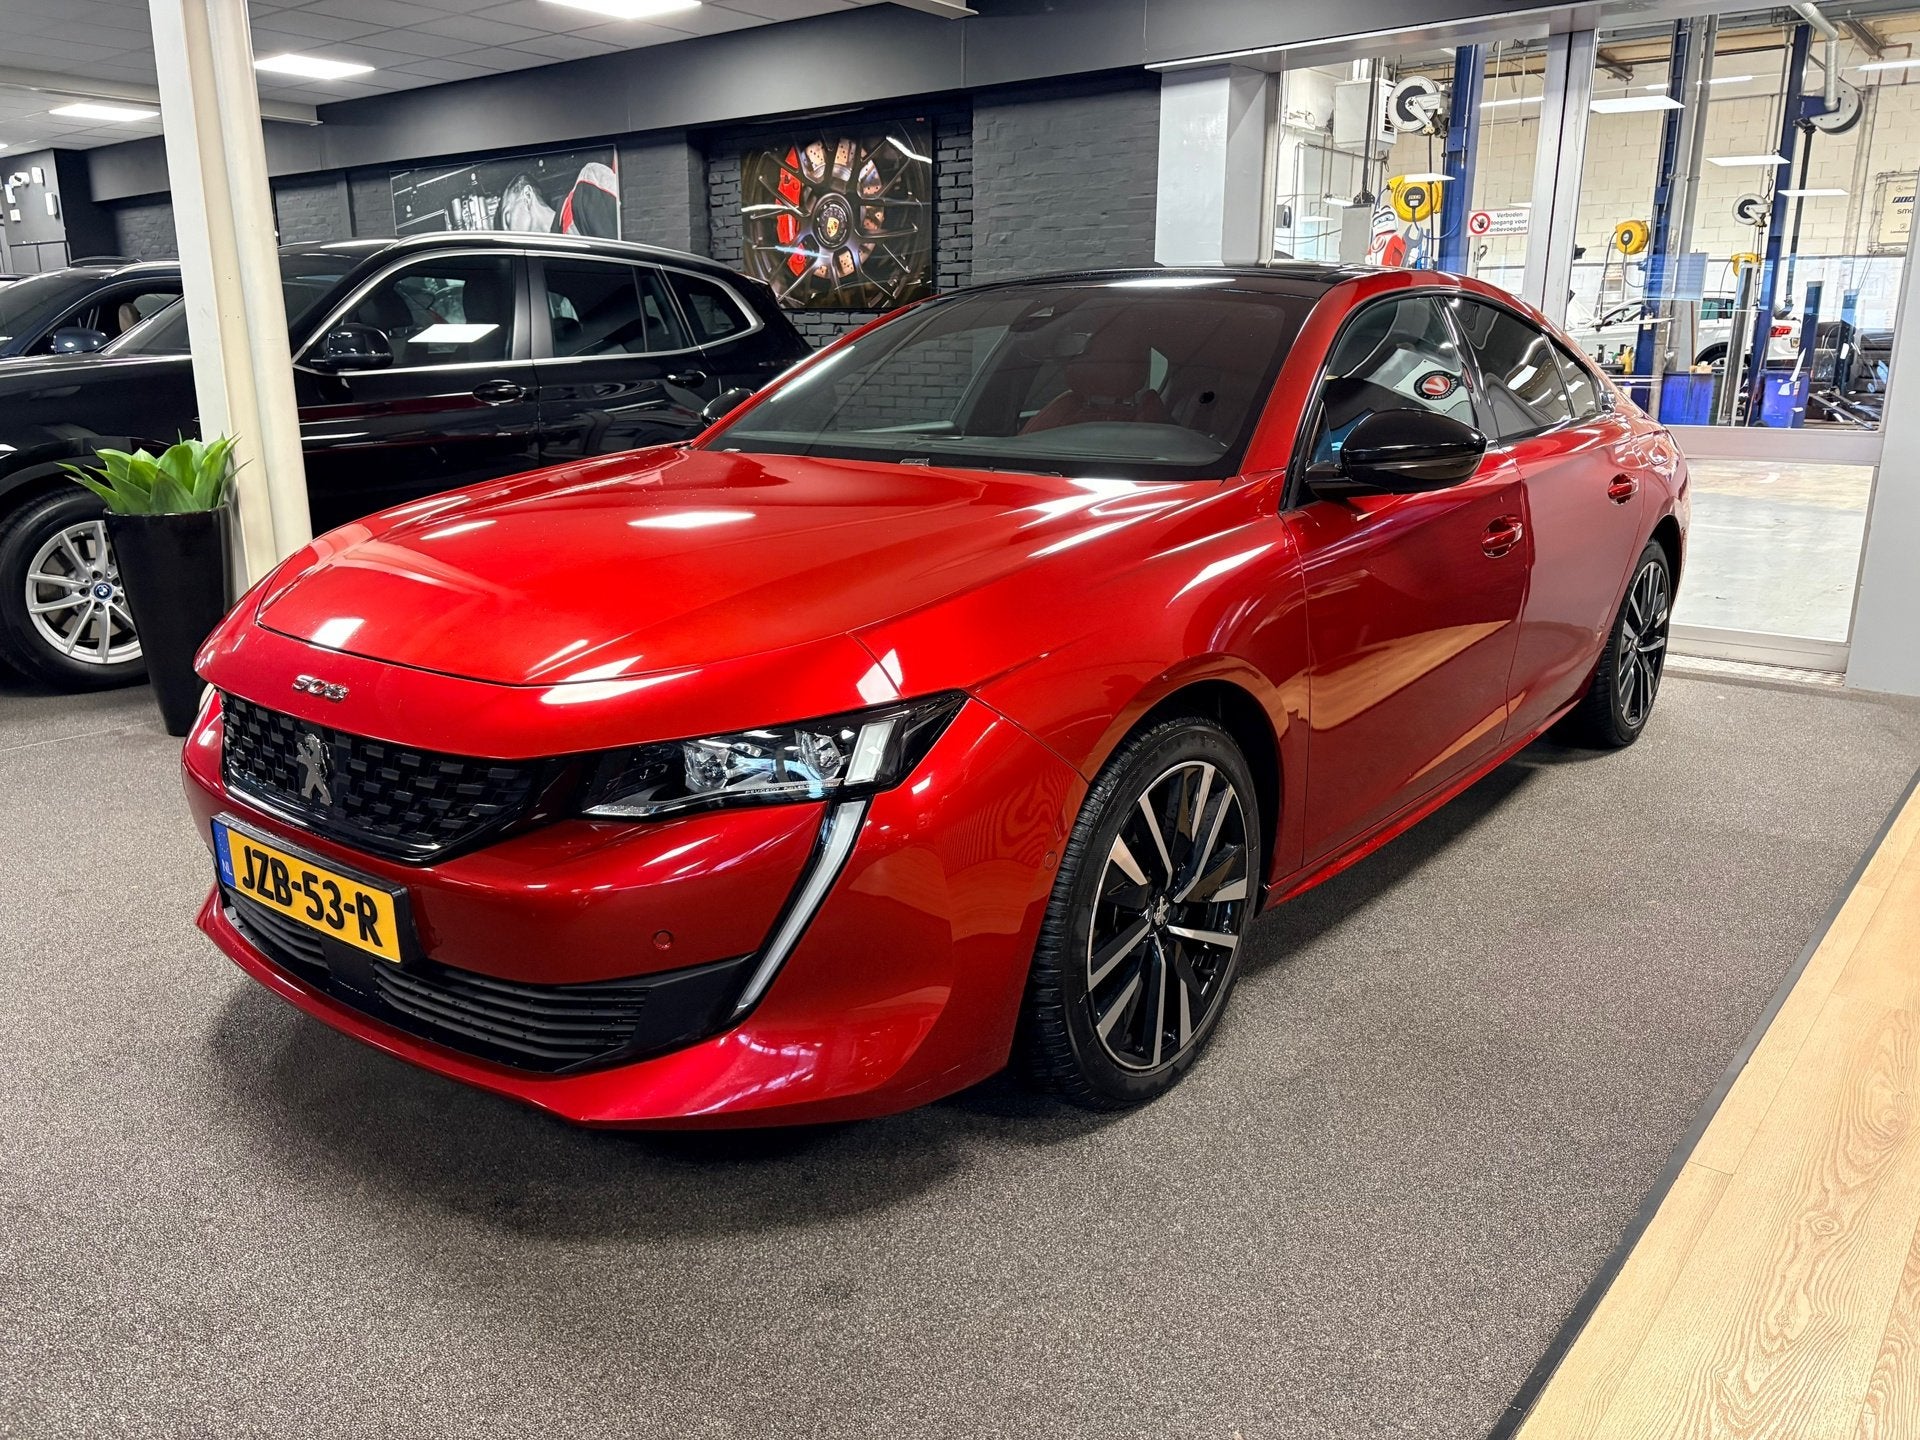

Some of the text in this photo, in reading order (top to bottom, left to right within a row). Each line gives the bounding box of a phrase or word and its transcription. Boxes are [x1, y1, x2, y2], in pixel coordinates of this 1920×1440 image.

[291, 673, 350, 700] 508
[221, 858, 233, 877] NL
[242, 845, 384, 948] JZB-53-R
